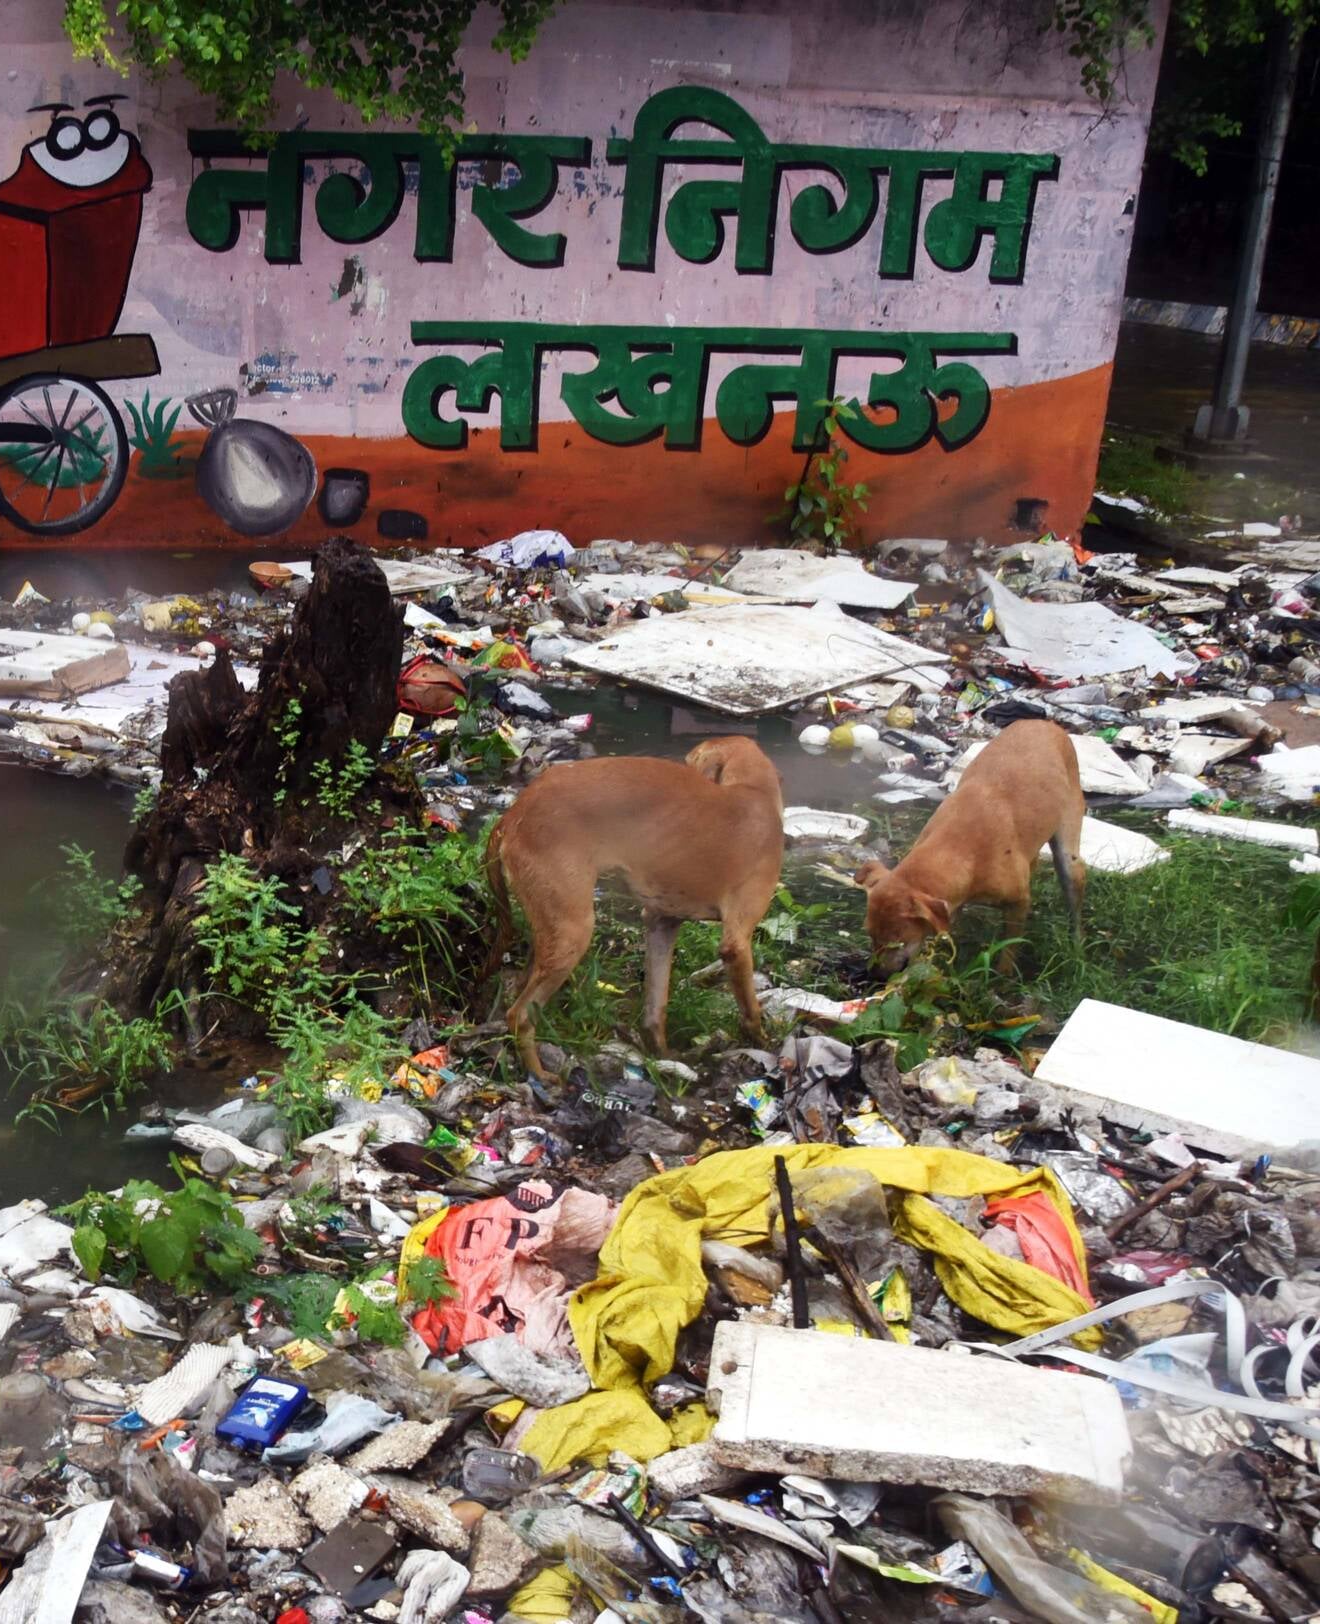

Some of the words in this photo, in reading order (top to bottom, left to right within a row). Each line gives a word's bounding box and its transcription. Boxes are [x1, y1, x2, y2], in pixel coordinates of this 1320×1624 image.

[185, 130, 591, 268] नगर
[607, 86, 1060, 284] निगम
[402, 321, 1019, 452] लखनऊ
